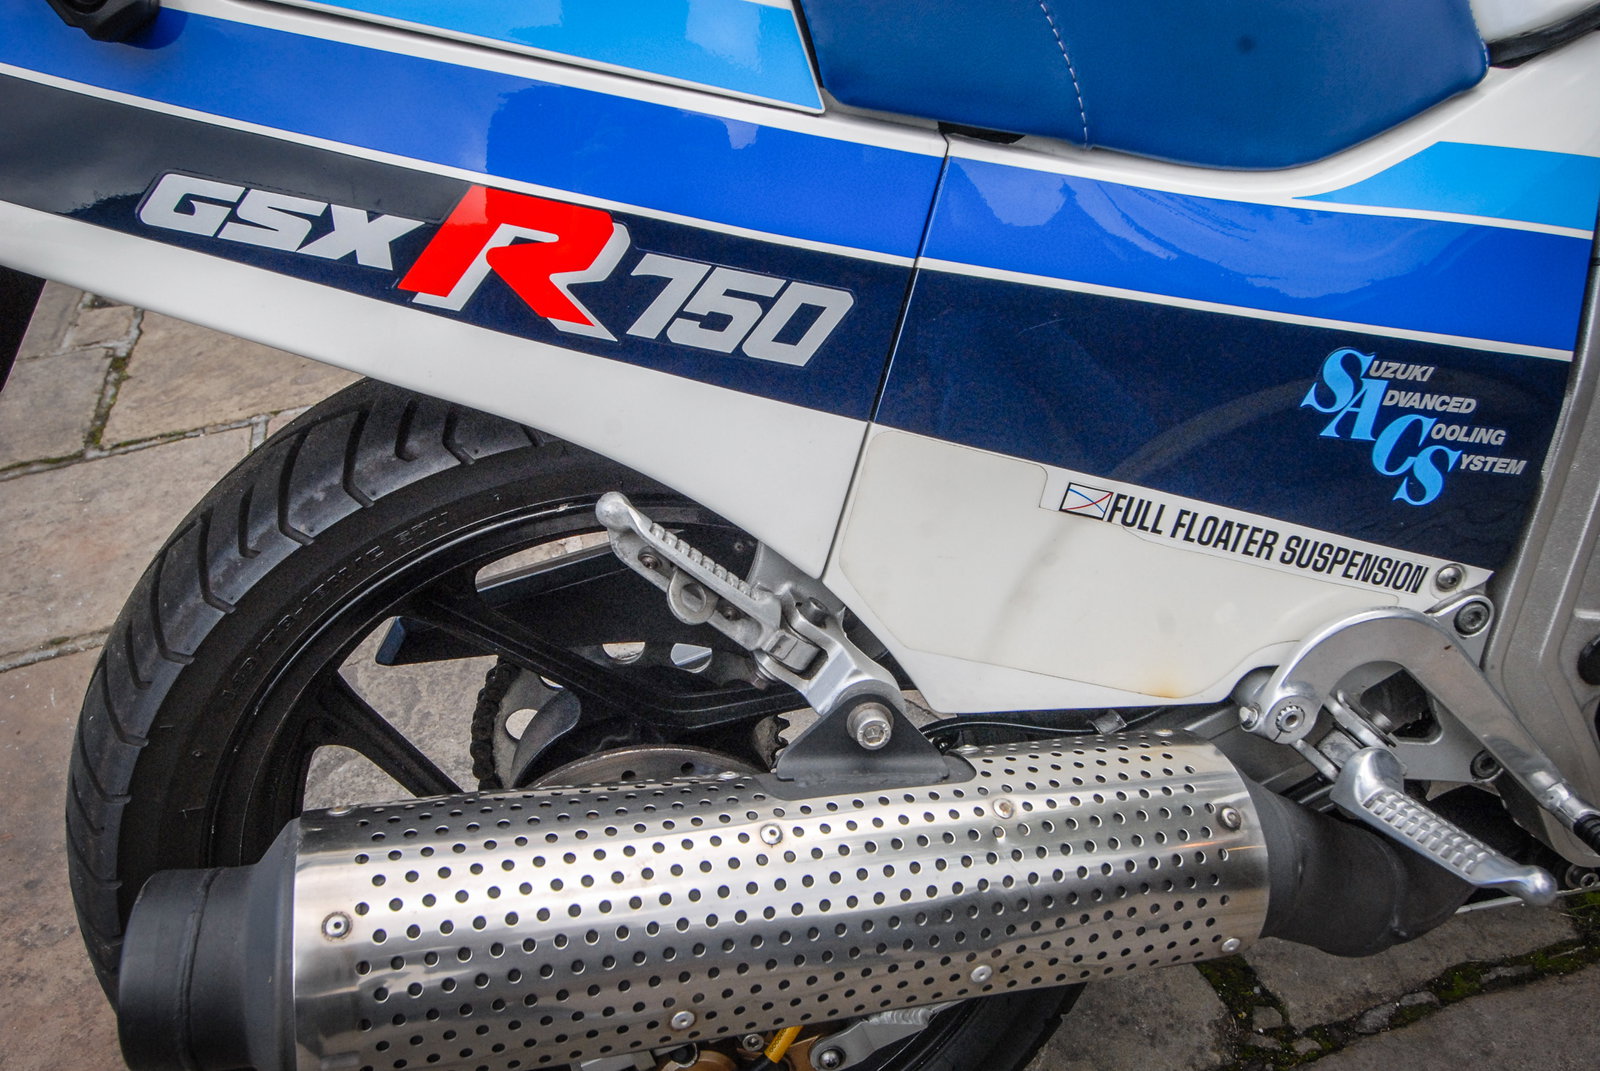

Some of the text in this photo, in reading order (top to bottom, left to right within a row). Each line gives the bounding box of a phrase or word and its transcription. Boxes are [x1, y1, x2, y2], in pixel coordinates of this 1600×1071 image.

[627, 253, 855, 366] 750
[1107, 493, 1430, 594] FULL FLOATER SUSPENSION
